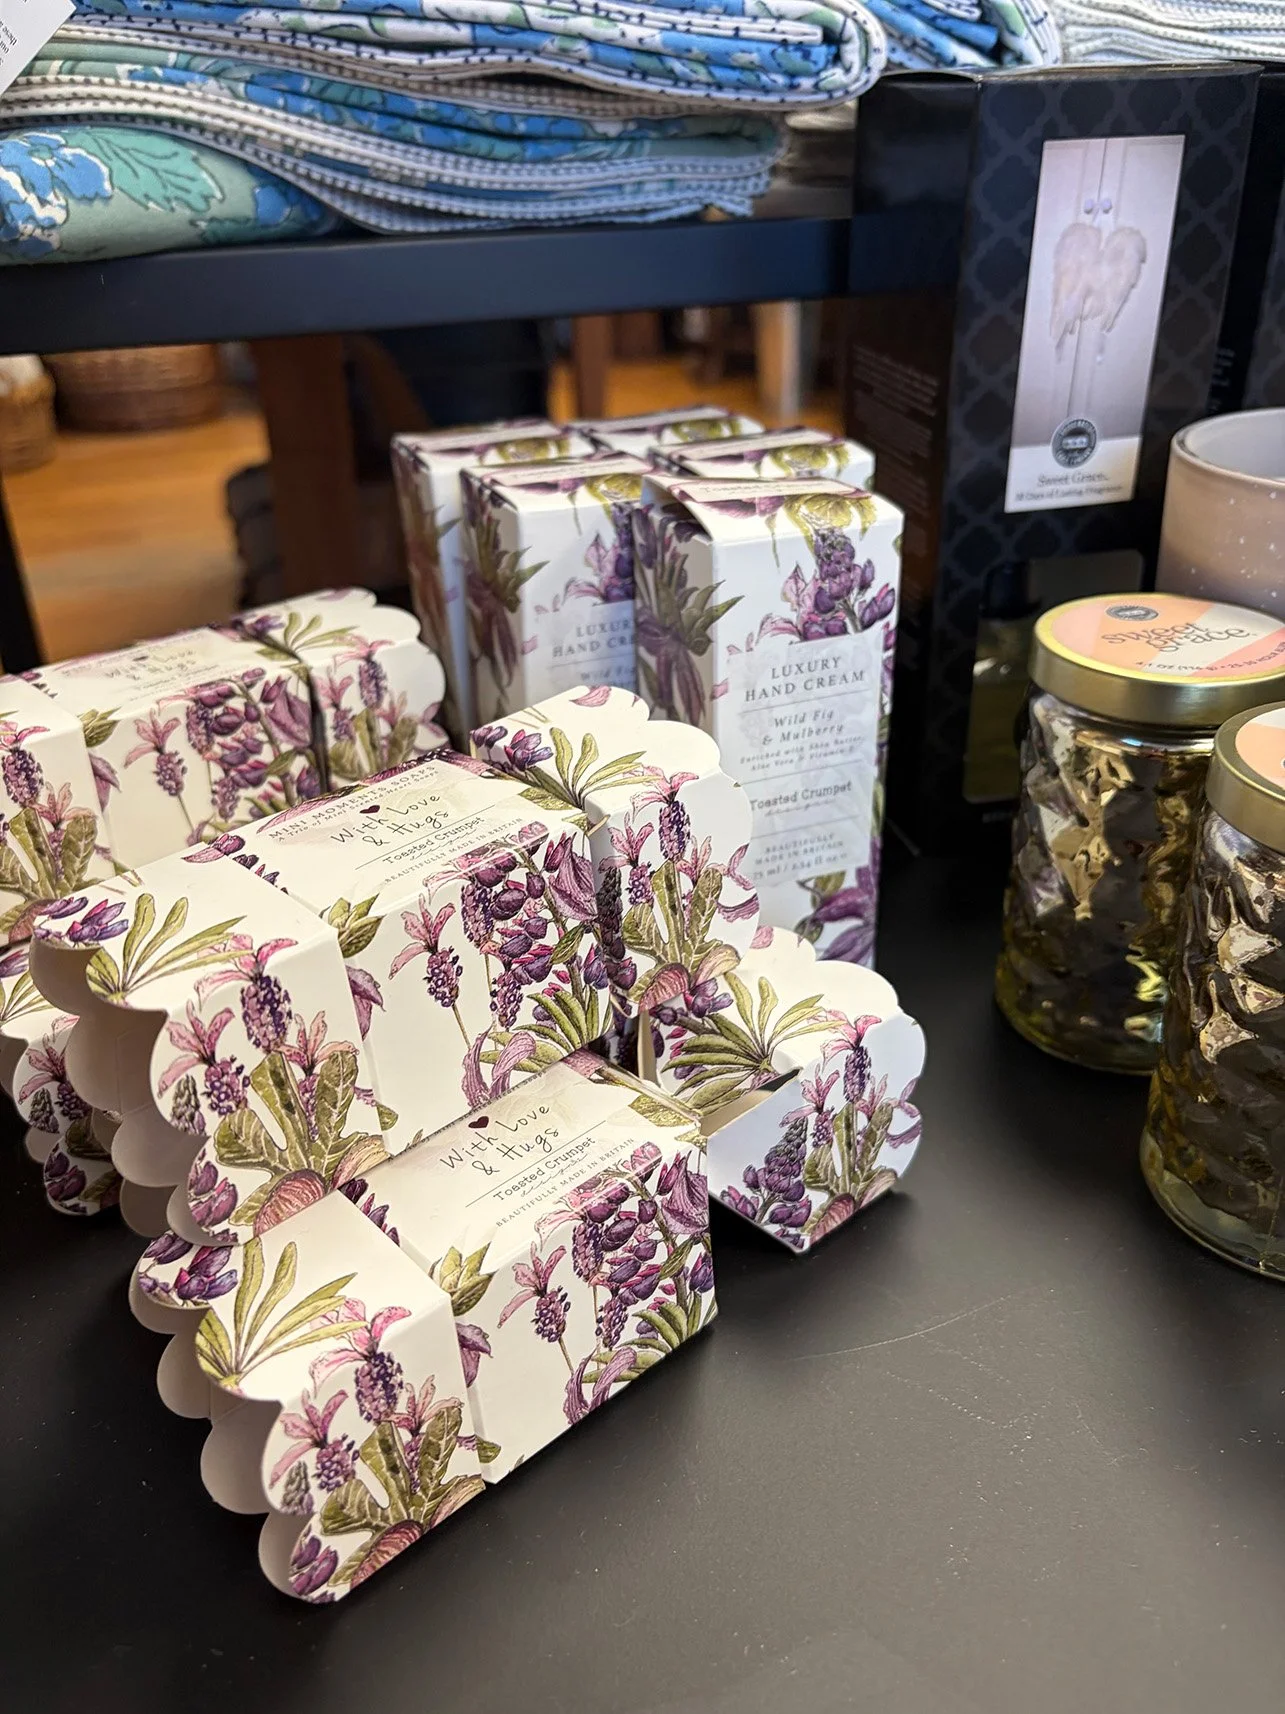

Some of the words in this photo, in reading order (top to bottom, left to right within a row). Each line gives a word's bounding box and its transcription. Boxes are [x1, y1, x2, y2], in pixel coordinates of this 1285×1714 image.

[552, 640, 601, 658] HAND
[1101, 622, 1211, 645] sweet
[1145, 626, 1250, 653] grace
[745, 682, 797, 703] HAND
[803, 670, 865, 691] CREAM
[771, 656, 842, 680] LUXURY
[762, 734, 774, 746] &
[780, 724, 845, 744] Mulberry
[774, 712, 807, 729] Wild
[813, 709, 835, 722] Fig
[268, 820, 307, 840] MINI
[312, 785, 389, 822] MOMENTS
[391, 765, 437, 787] SOAPS
[750, 791, 798, 812] Toasted
[801, 780, 852, 801] Crumpet
[330, 814, 389, 845] With
[386, 794, 442, 817] Love
[362, 834, 390, 848] &
[386, 809, 449, 837] Hugs
[382, 838, 434, 865] Toasted
[434, 816, 485, 843] Crumpet
[384, 851, 447, 884] BEAUTIFULLY
[448, 839, 475, 854] MADE
[477, 832, 488, 843] IN
[488, 817, 523, 837] BRITAIN
[440, 1131, 499, 1170] With
[495, 1104, 550, 1133] Love
[471, 1160, 501, 1176] &
[496, 1126, 560, 1161] Hugs
[493, 1168, 545, 1201] Toasted
[544, 1136, 596, 1171] Crumpet
[495, 1185, 559, 1228] BEAUTIFULLY
[560, 1168, 587, 1187] MADE
[588, 1159, 599, 1171] IN
[599, 1137, 636, 1162] BRITAIN
